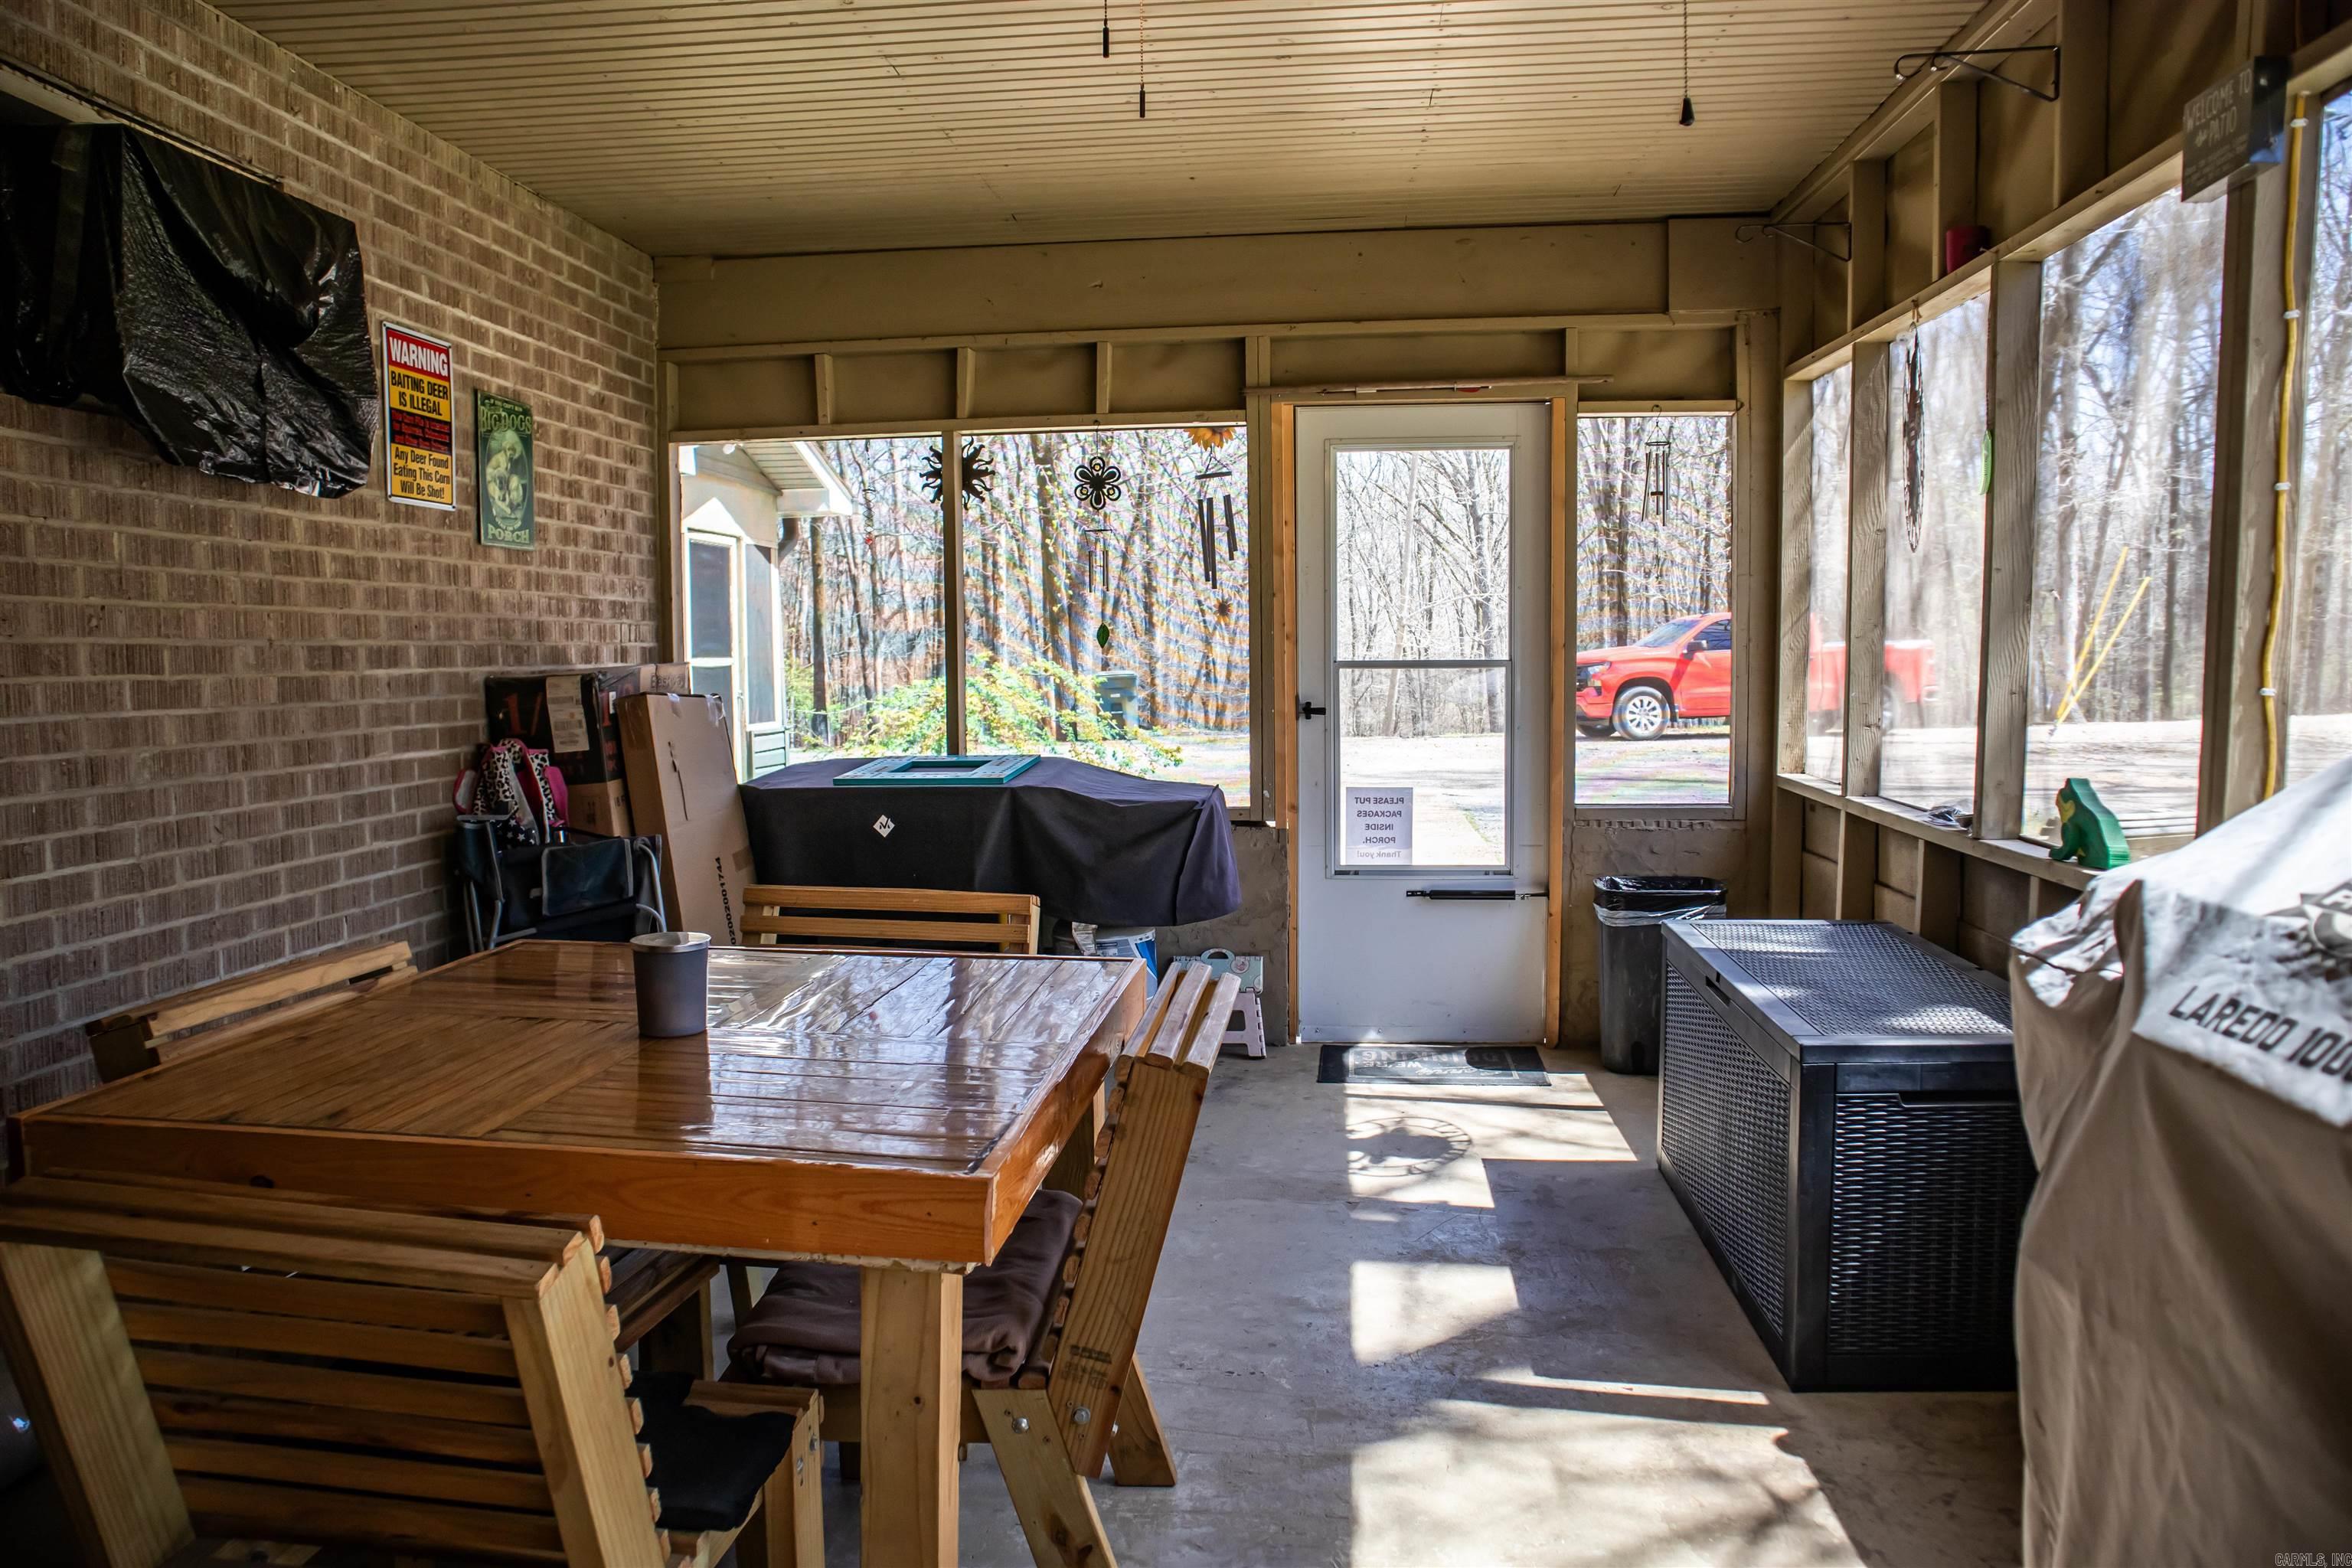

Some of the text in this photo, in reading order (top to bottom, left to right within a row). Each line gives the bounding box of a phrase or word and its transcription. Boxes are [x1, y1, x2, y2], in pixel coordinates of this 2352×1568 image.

[2183, 68, 2252, 132] WELCOME TO
[2209, 106, 2237, 145] PATIO
[389, 337, 449, 377] WARNING
[390, 371, 449, 400] BAITING DEER
[399, 391, 443, 416] IS ILLEGAL
[478, 406, 499, 432] BIG
[501, 412, 531, 434] DOGS
[395, 446, 449, 469] Any Deer Found
[394, 462, 450, 485] Eating This Corn
[400, 480, 445, 499] Will Be Shot!
[488, 523, 530, 544] PORCH
[715, 857, 737, 945] 02002001744
[2168, 985, 2352, 1084] LAREDO 100
